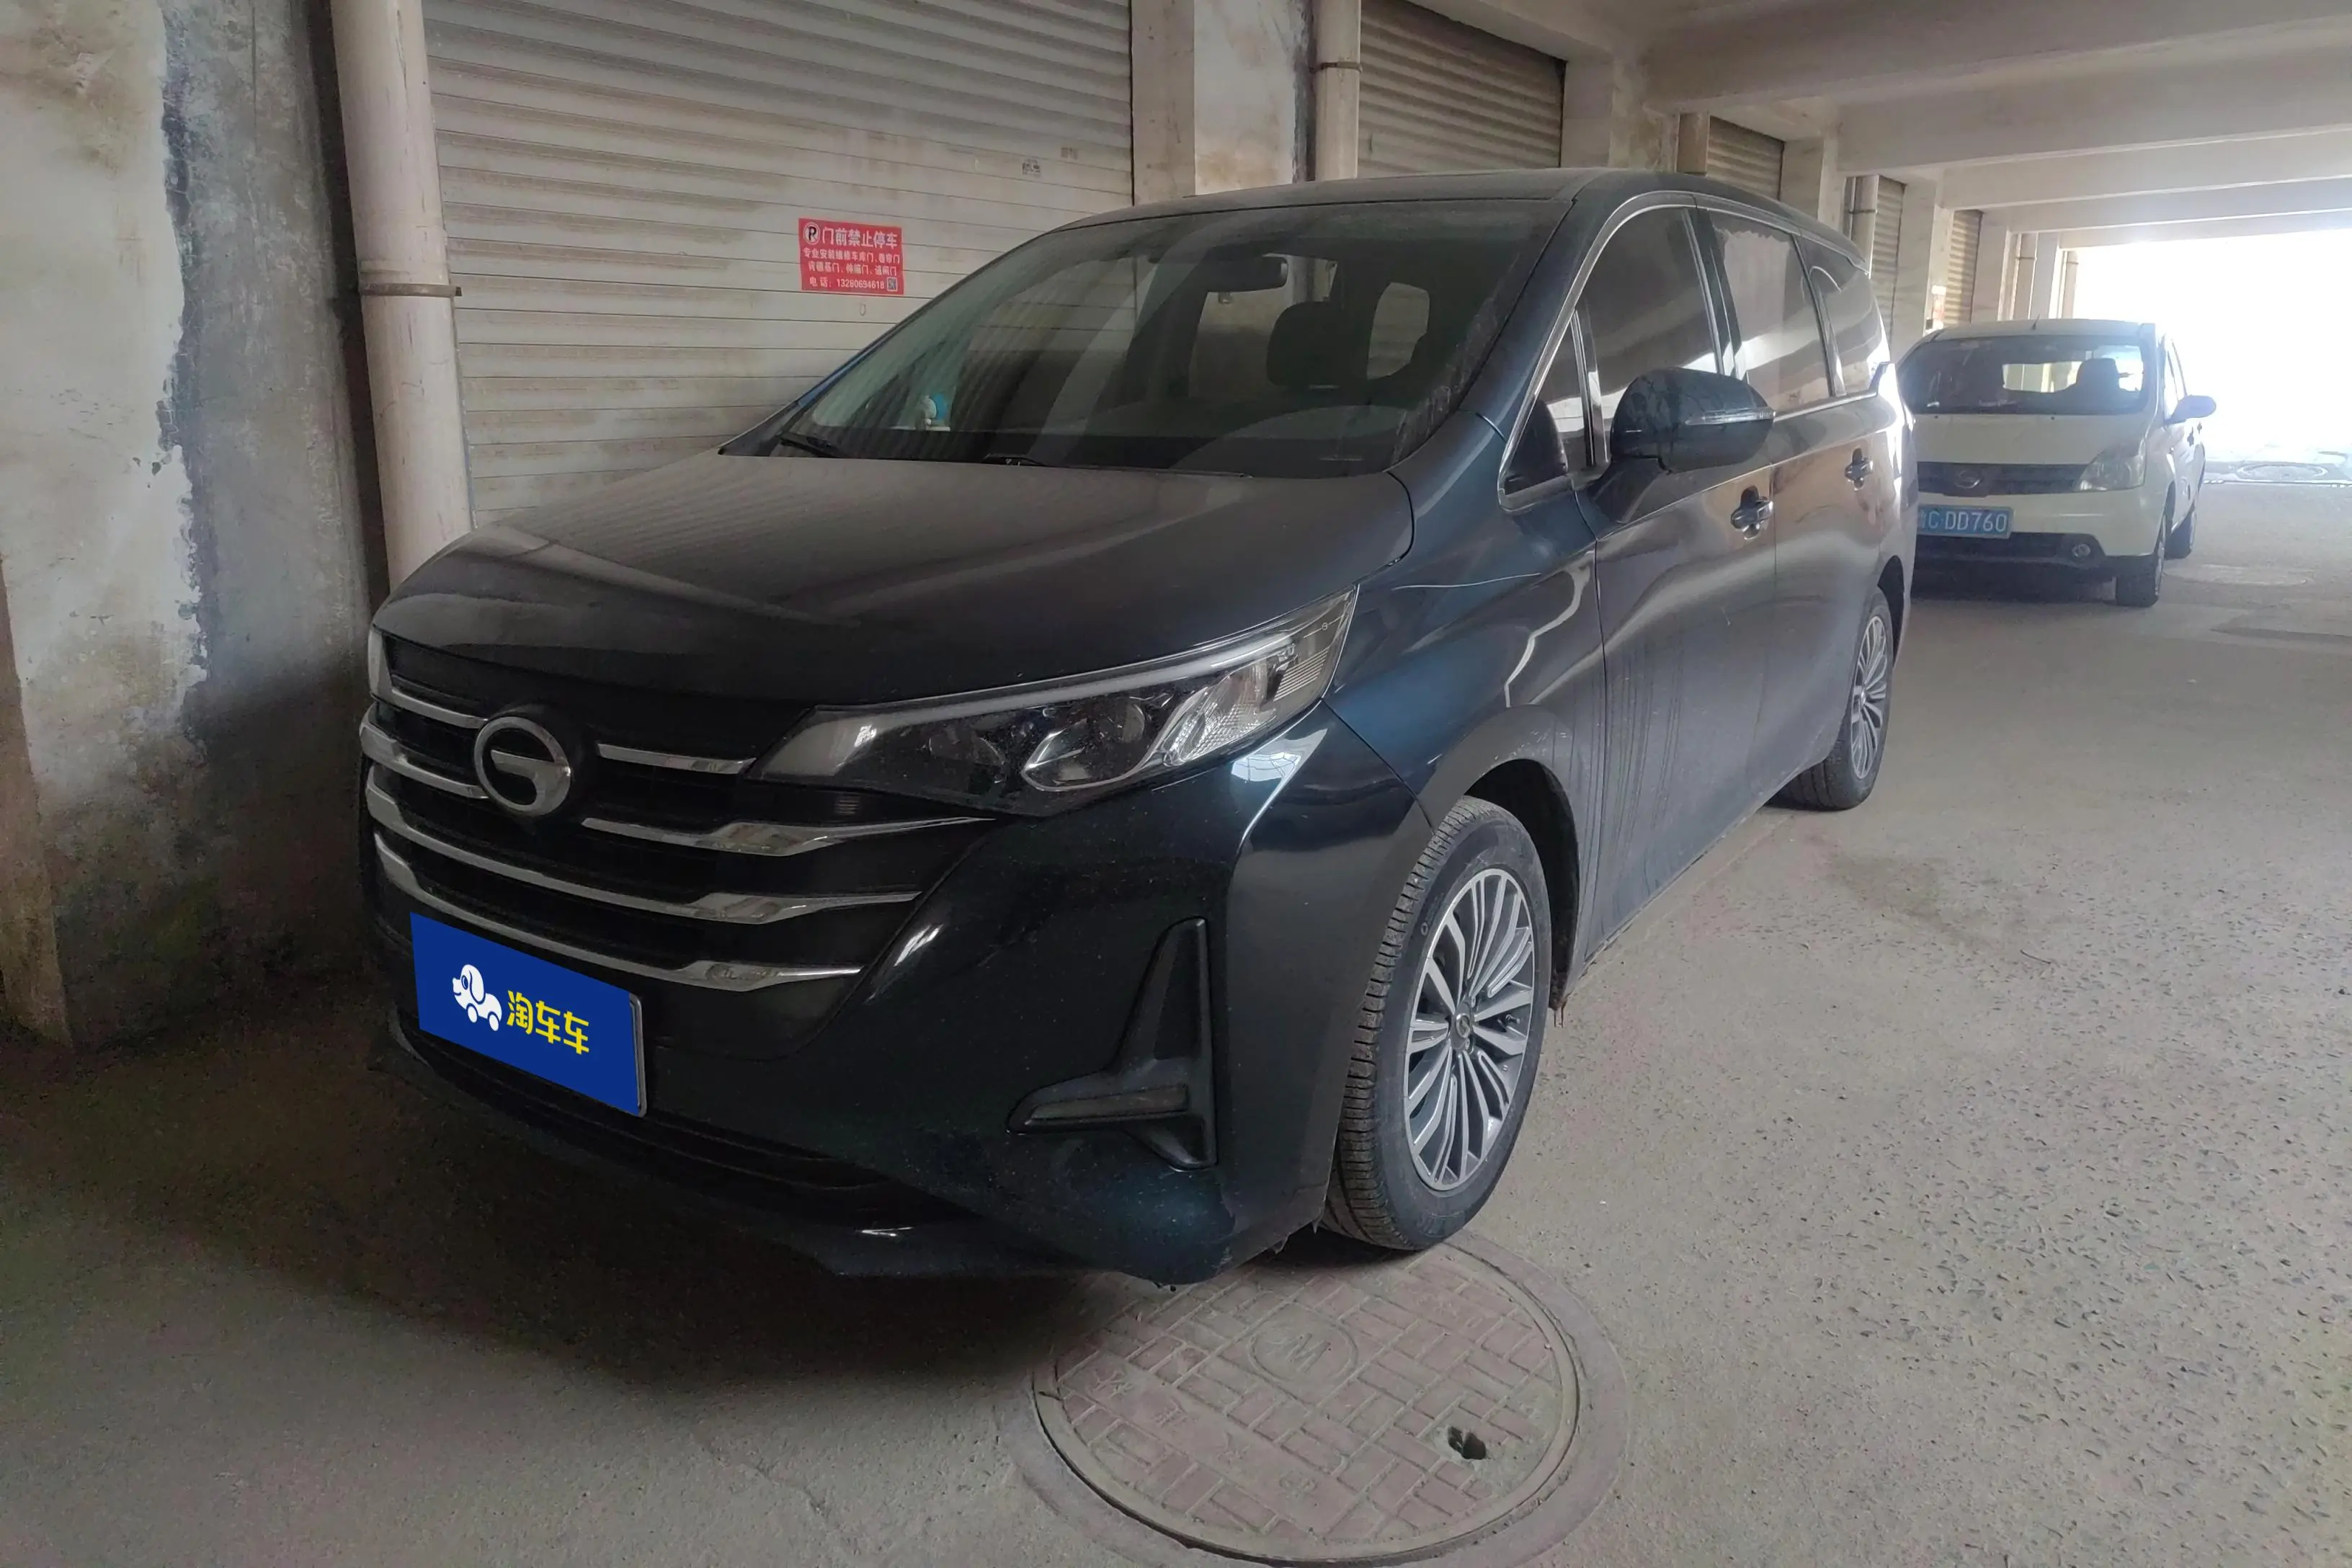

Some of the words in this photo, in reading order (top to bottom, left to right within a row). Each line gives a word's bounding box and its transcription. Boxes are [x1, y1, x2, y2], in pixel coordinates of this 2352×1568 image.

[822, 227, 898, 249] 门前禁止停车
